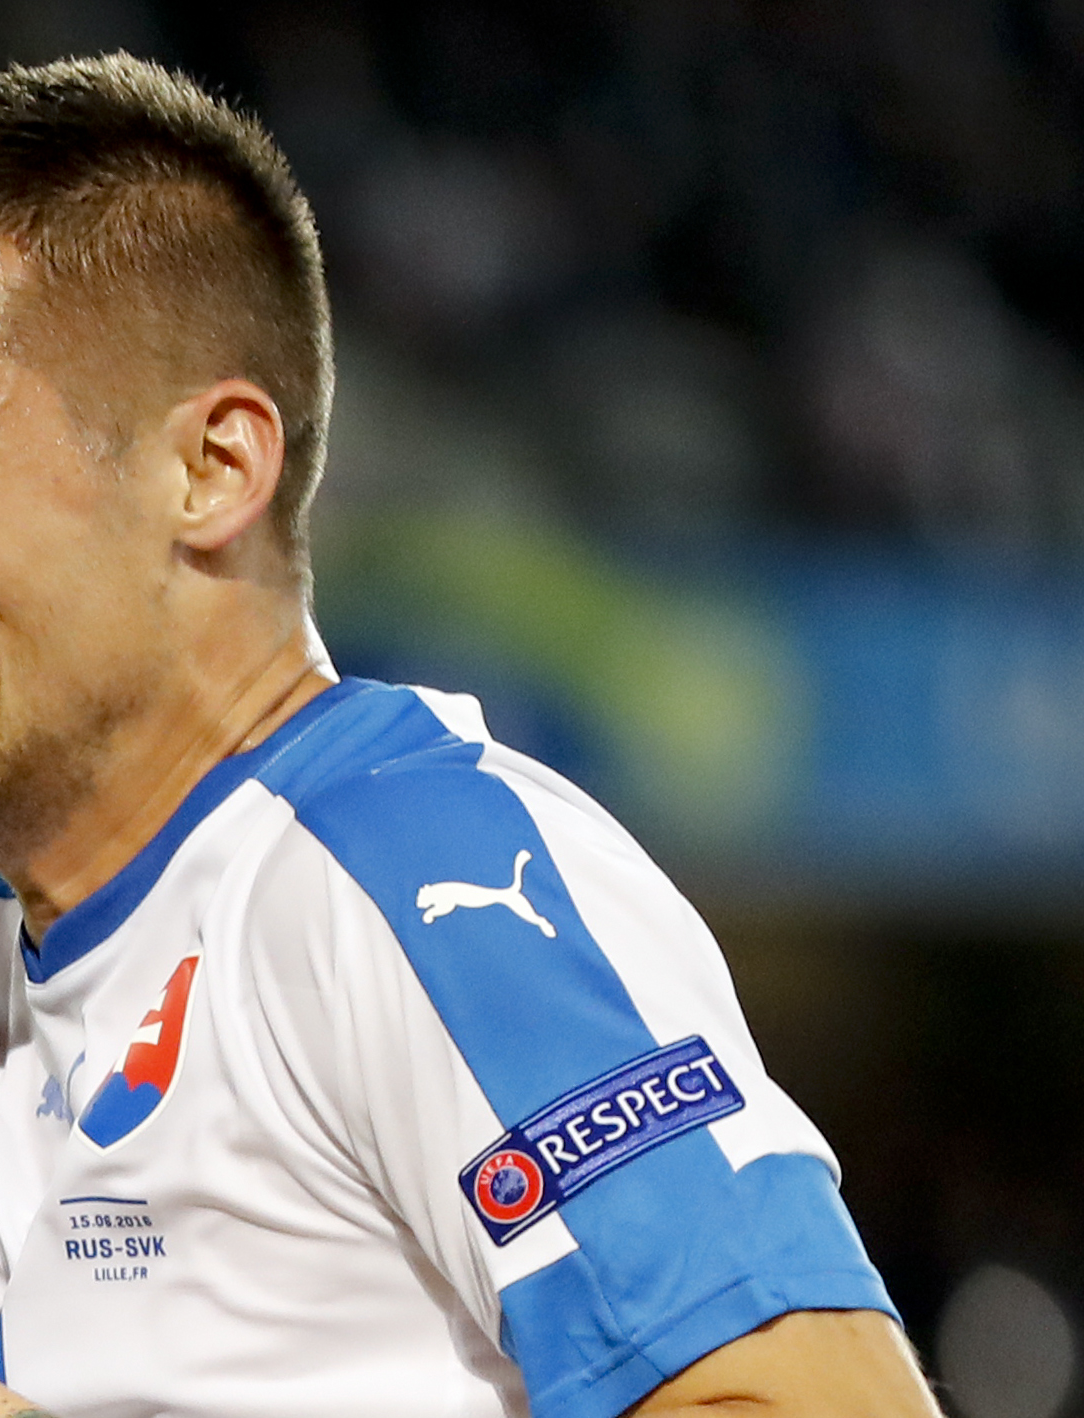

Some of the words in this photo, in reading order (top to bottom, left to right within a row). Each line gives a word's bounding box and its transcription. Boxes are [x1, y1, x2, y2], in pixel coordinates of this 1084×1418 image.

[537, 1055, 723, 1174] RESPECT
[480, 1155, 515, 1185] UEFA
[69, 1215, 152, 1229] 15.06.2016
[65, 1236, 166, 1259] RUS-SVK
[94, 1267, 148, 1281] LILLE,FR
